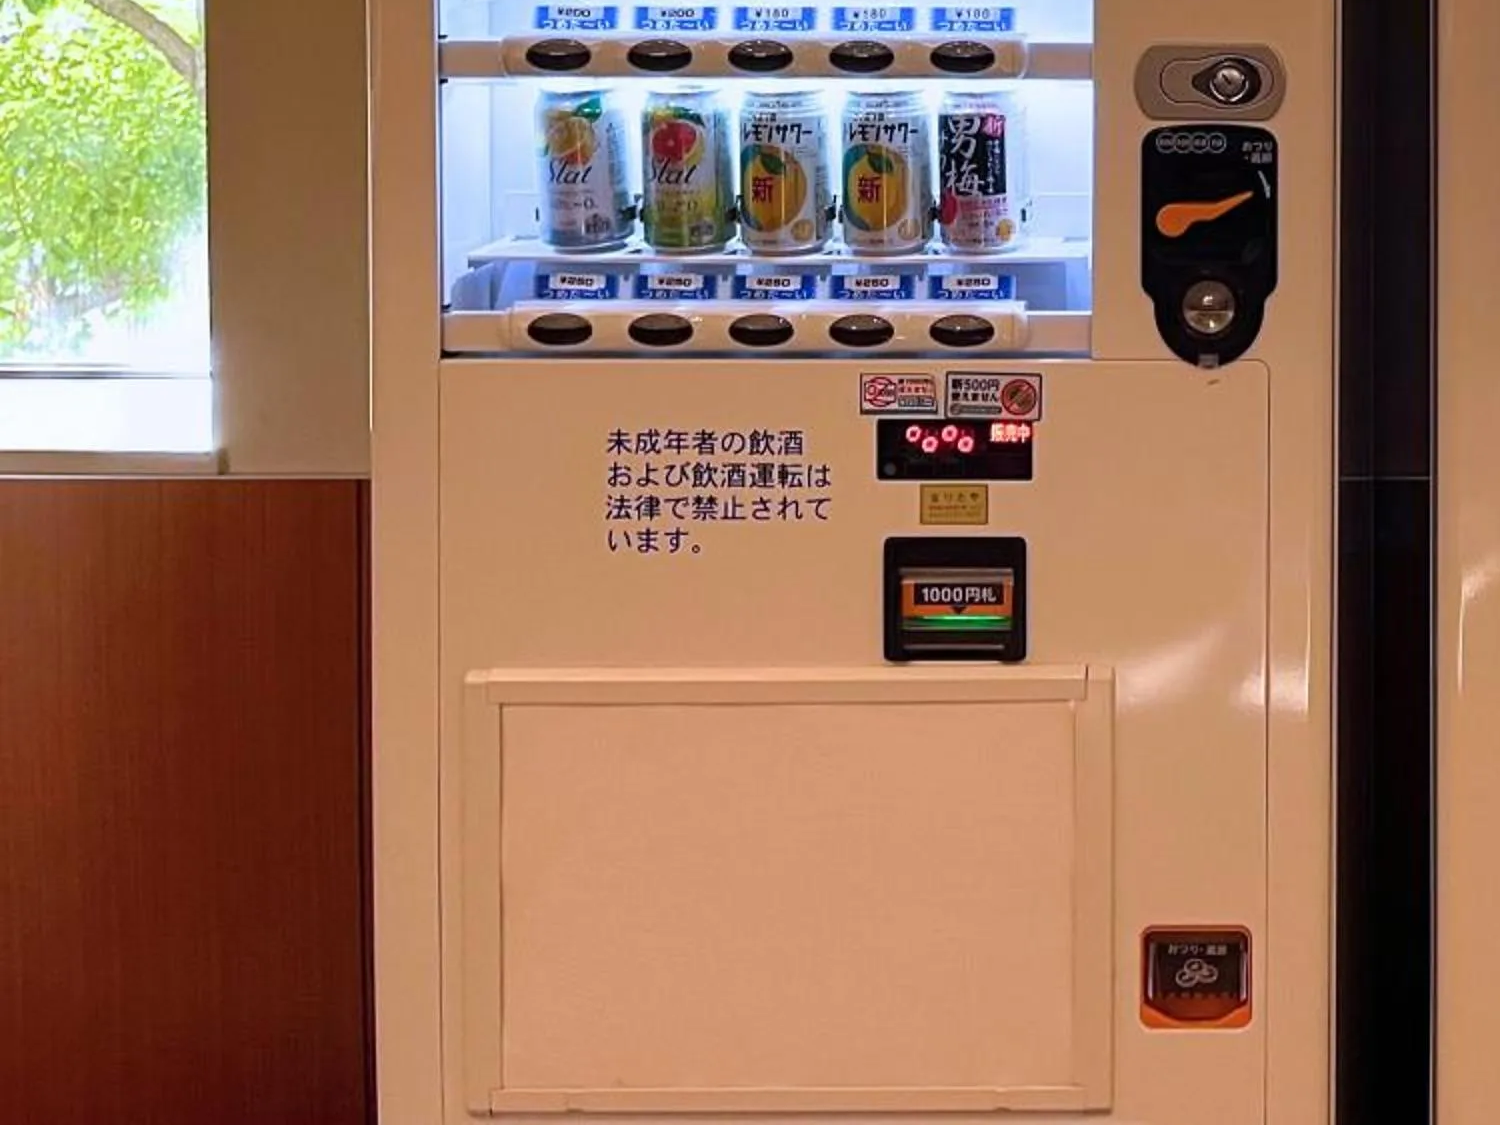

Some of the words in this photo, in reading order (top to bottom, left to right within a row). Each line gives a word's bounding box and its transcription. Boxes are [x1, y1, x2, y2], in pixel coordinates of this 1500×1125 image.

[751, 175, 774, 203] 新
[857, 175, 882, 203] 新
[606, 428, 804, 456] 未成年者の飲酒
[607, 462, 832, 489] および飲酒運転は
[605, 494, 832, 521] 法律で禁止されて
[607, 527, 701, 554] います。
[921, 586, 997, 603] 1000円札
